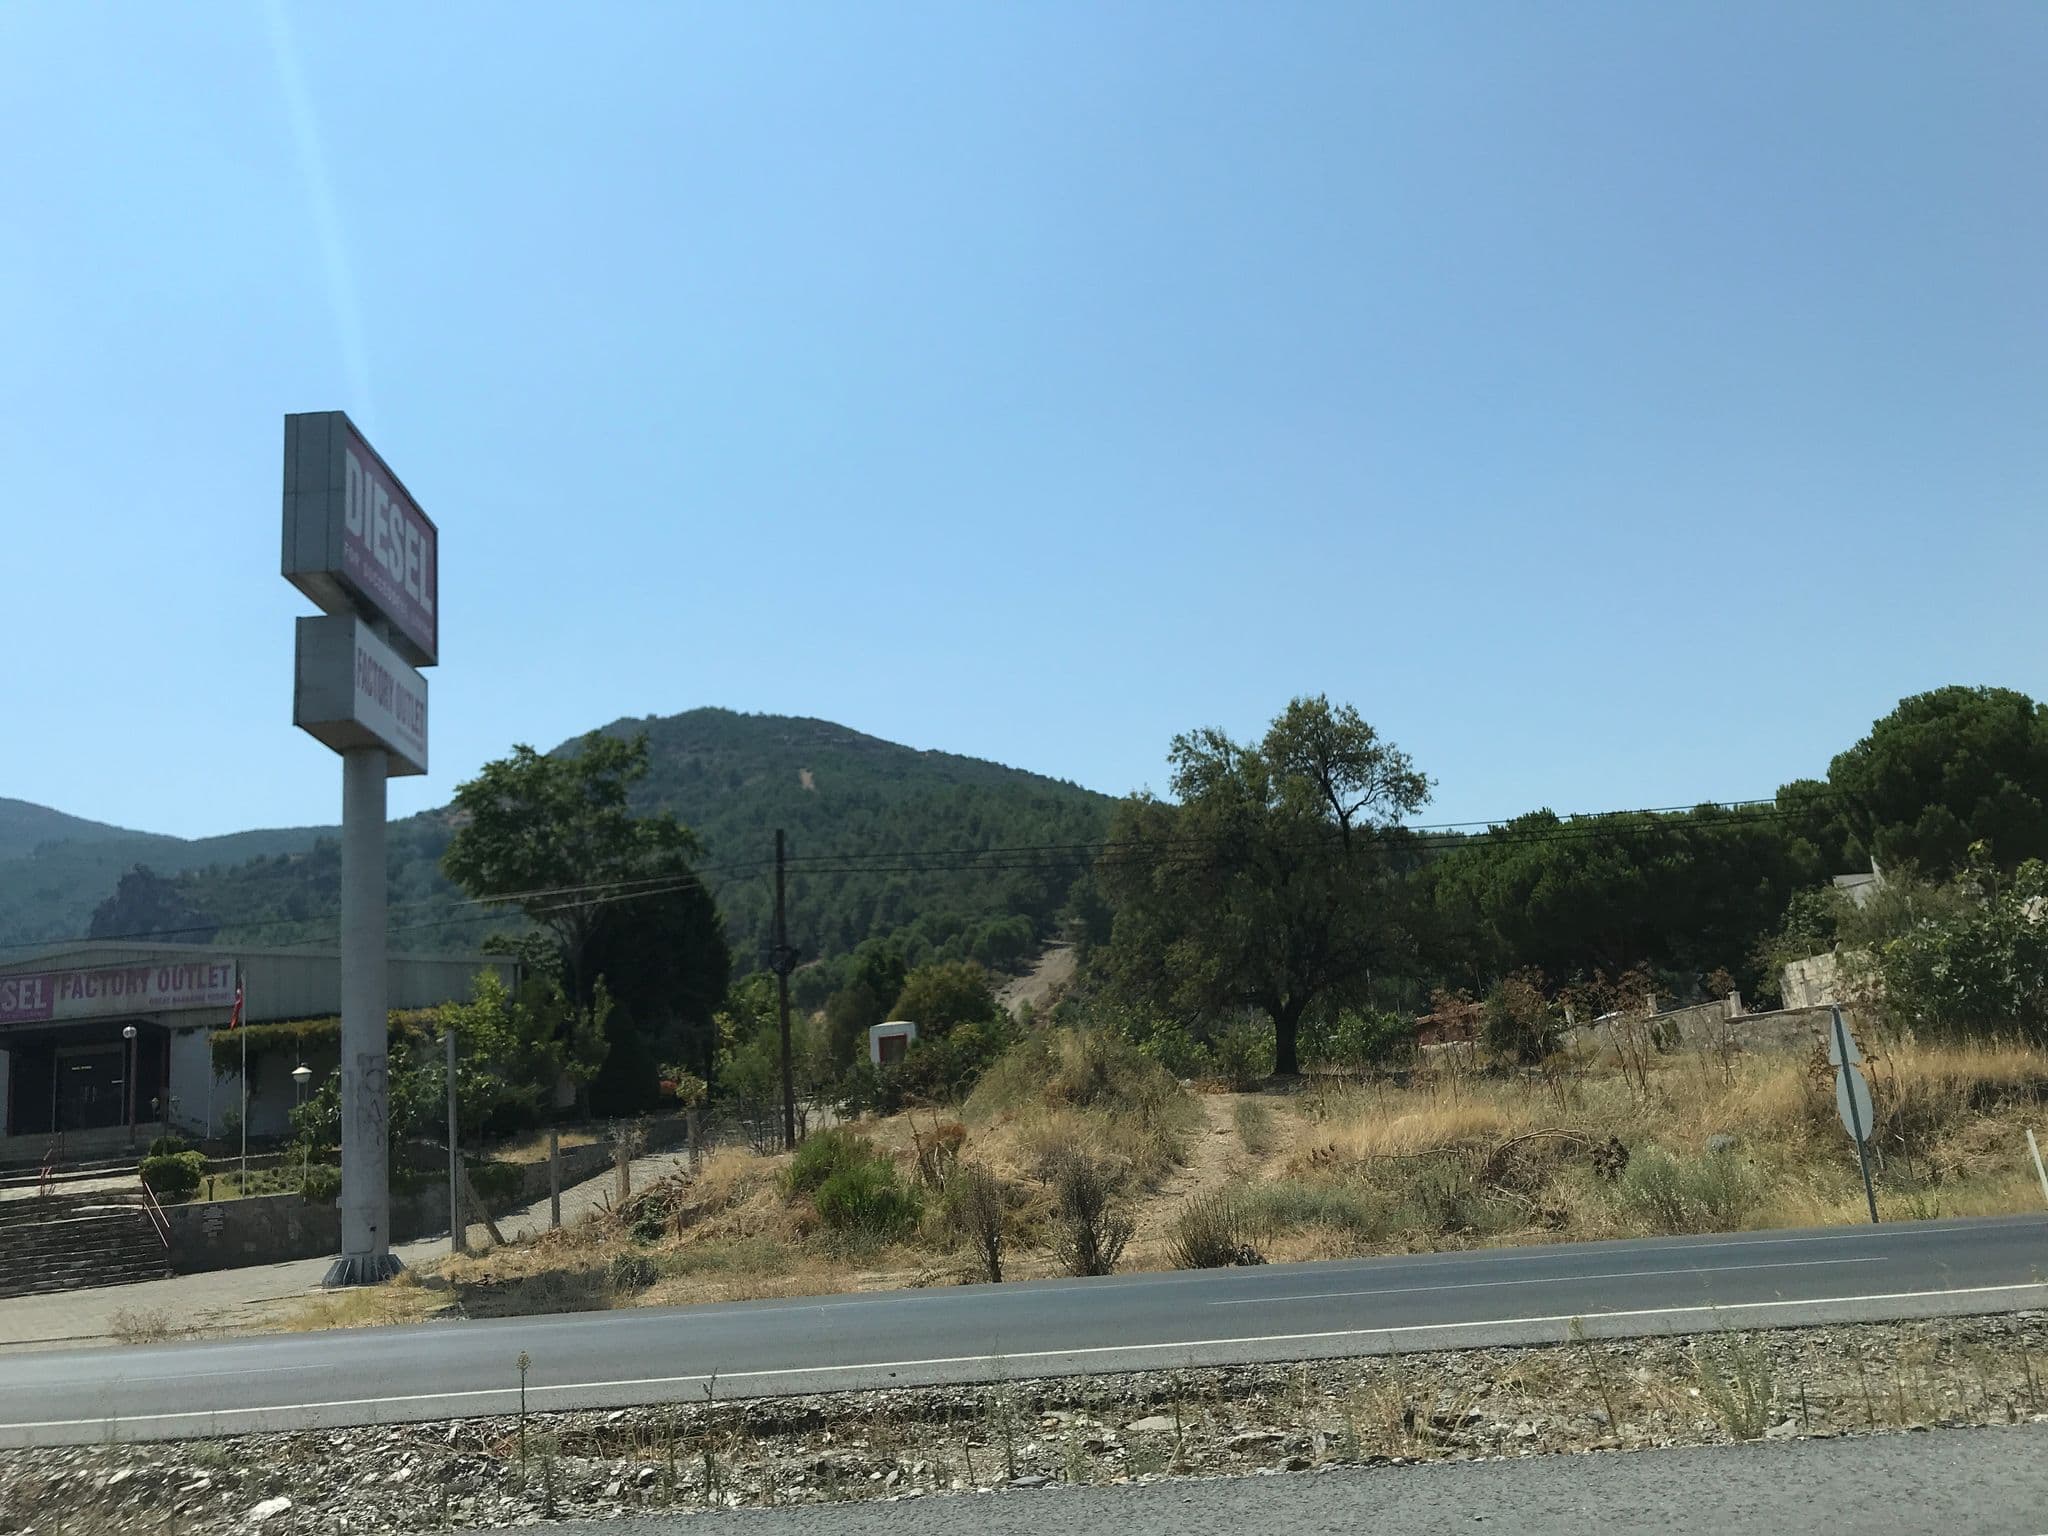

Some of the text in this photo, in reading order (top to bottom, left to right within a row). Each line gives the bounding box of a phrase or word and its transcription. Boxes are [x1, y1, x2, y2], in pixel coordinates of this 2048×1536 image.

[345, 449, 433, 616] DIESEL
[0, 979, 48, 1012] SEL
[59, 967, 151, 1001] FACTORY
[157, 963, 231, 993] OUTLET
